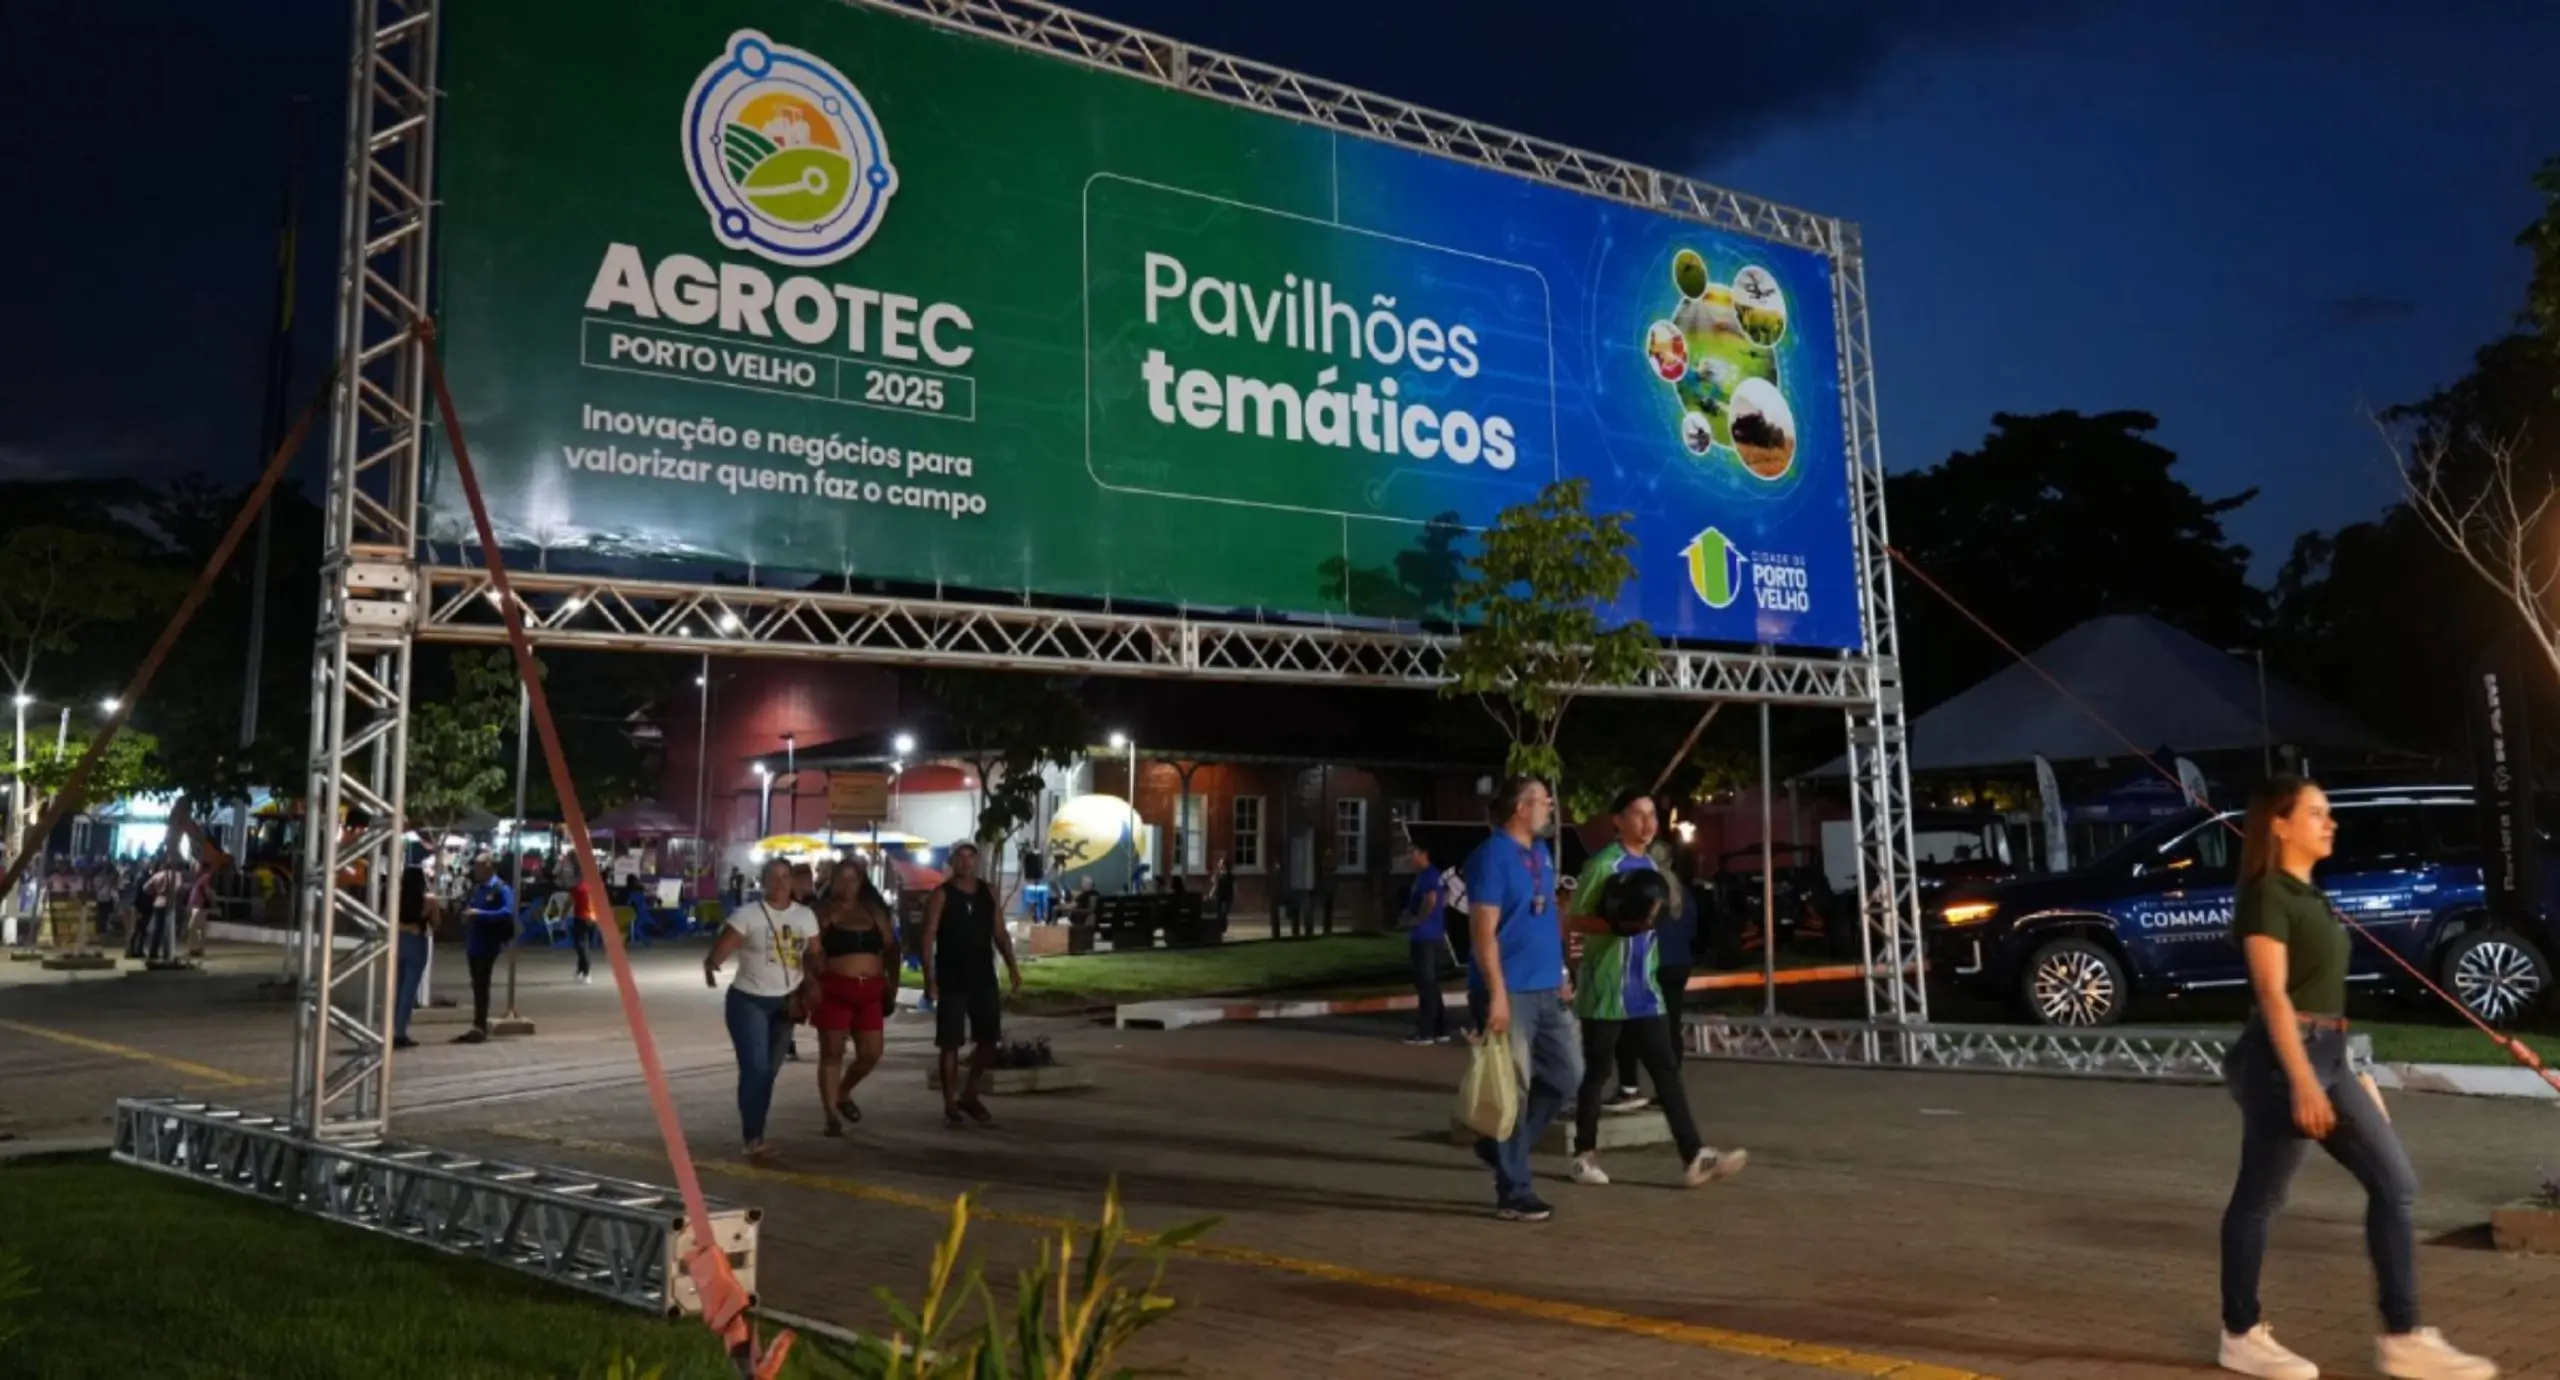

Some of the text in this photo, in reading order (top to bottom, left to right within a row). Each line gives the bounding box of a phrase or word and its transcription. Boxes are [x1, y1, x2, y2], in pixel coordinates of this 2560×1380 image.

[585, 242, 974, 367] AGROTEC
[1145, 252, 1479, 378] Pavilhões
[610, 333, 816, 387] PORTO VELHO
[865, 370, 945, 410] 2025
[583, 404, 973, 477] Inovação e negócios para
[1142, 349, 1516, 469] temáticos
[563, 446, 986, 519] valorizar quem faz o campo
[1753, 563, 1807, 589] PORTO
[1753, 586, 1809, 612] VELHO
